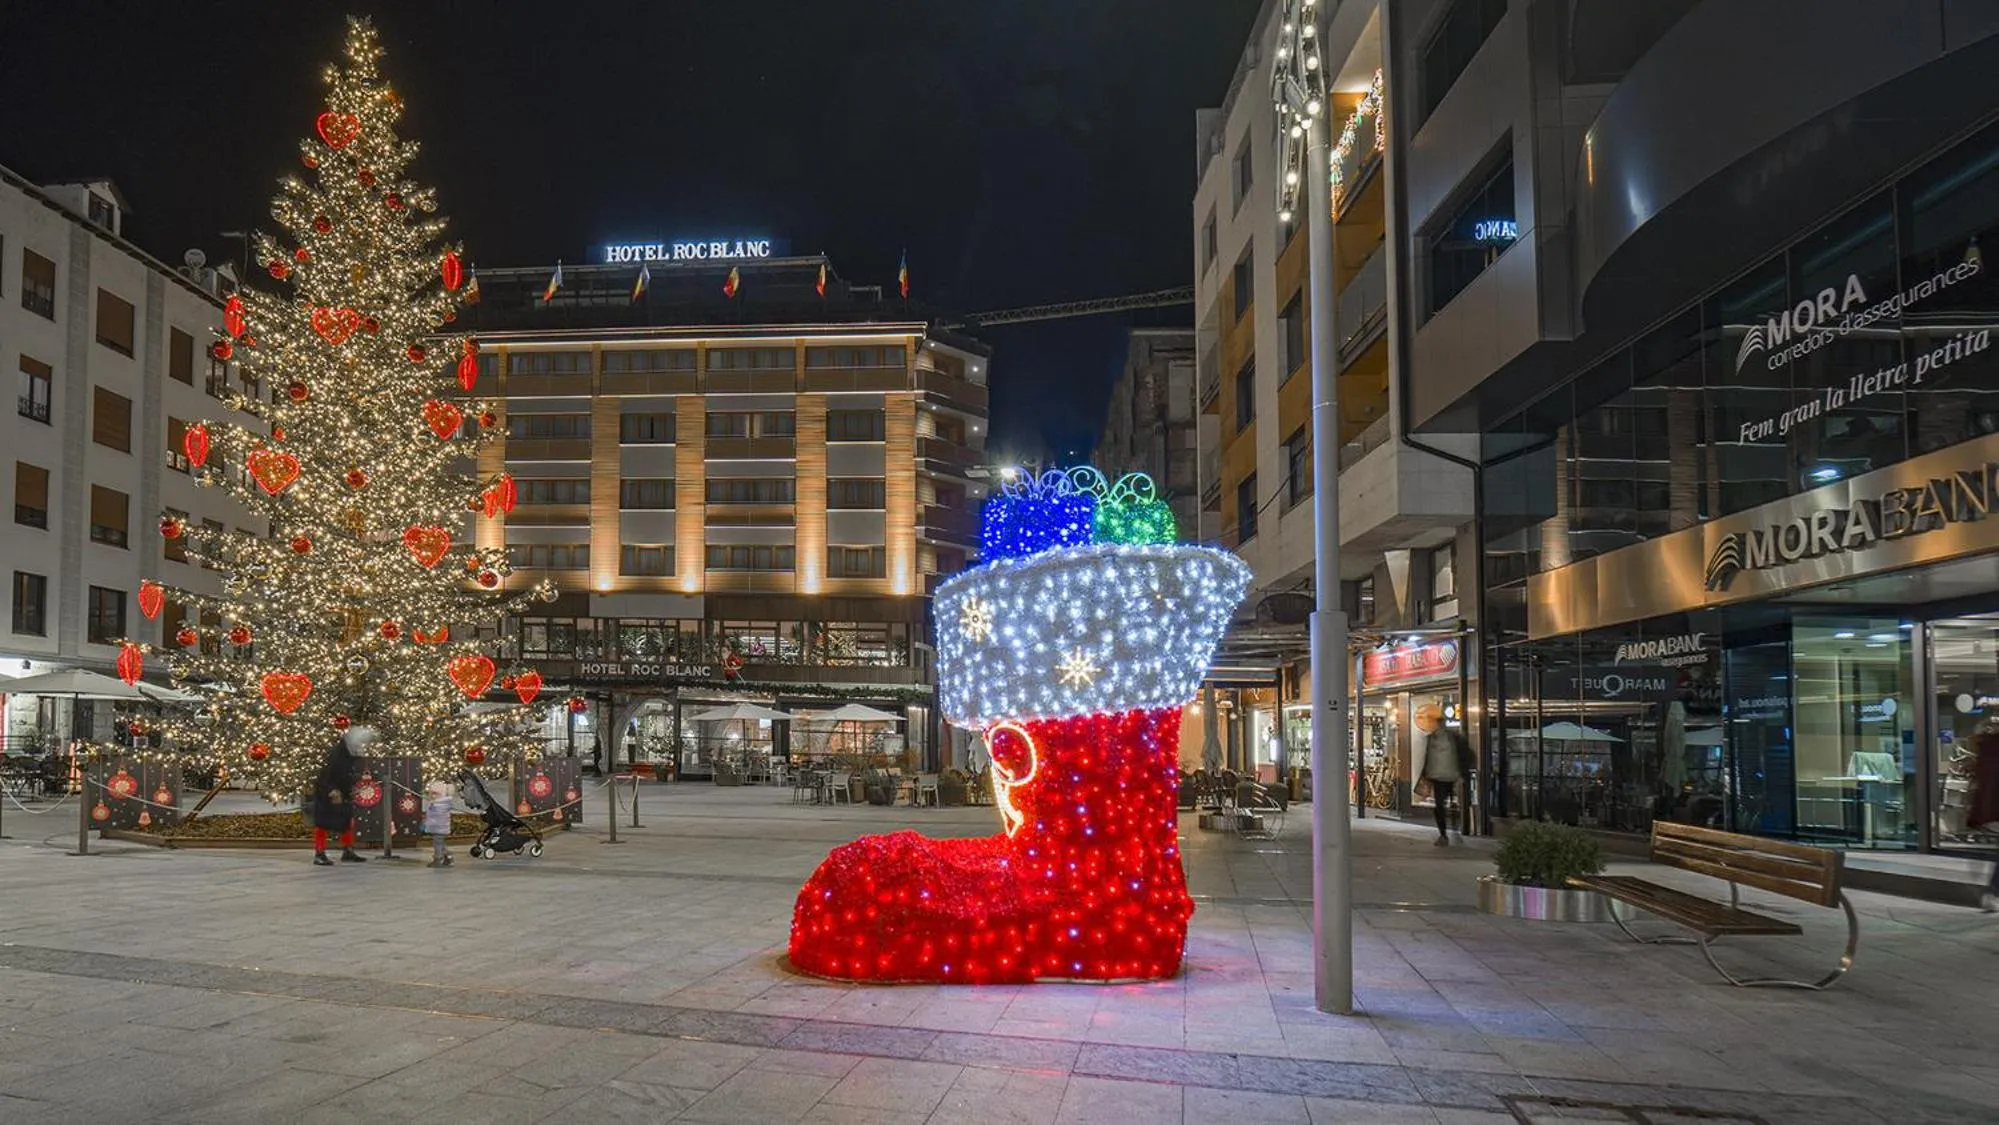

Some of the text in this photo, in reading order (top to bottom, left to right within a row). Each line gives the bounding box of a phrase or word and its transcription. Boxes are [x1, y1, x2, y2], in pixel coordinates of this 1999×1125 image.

[605, 240, 770, 262] HOTEL ROC BLANC
[1766, 273, 1868, 350] MORA
[1767, 257, 1980, 371] corredors d'assegurances
[1738, 328, 1991, 445] Fem gran la lletra petita
[1745, 462, 1999, 570] MORABAN
[581, 663, 711, 677] HOTEL ROC BLANC
[1627, 632, 1708, 660] MORABANC
